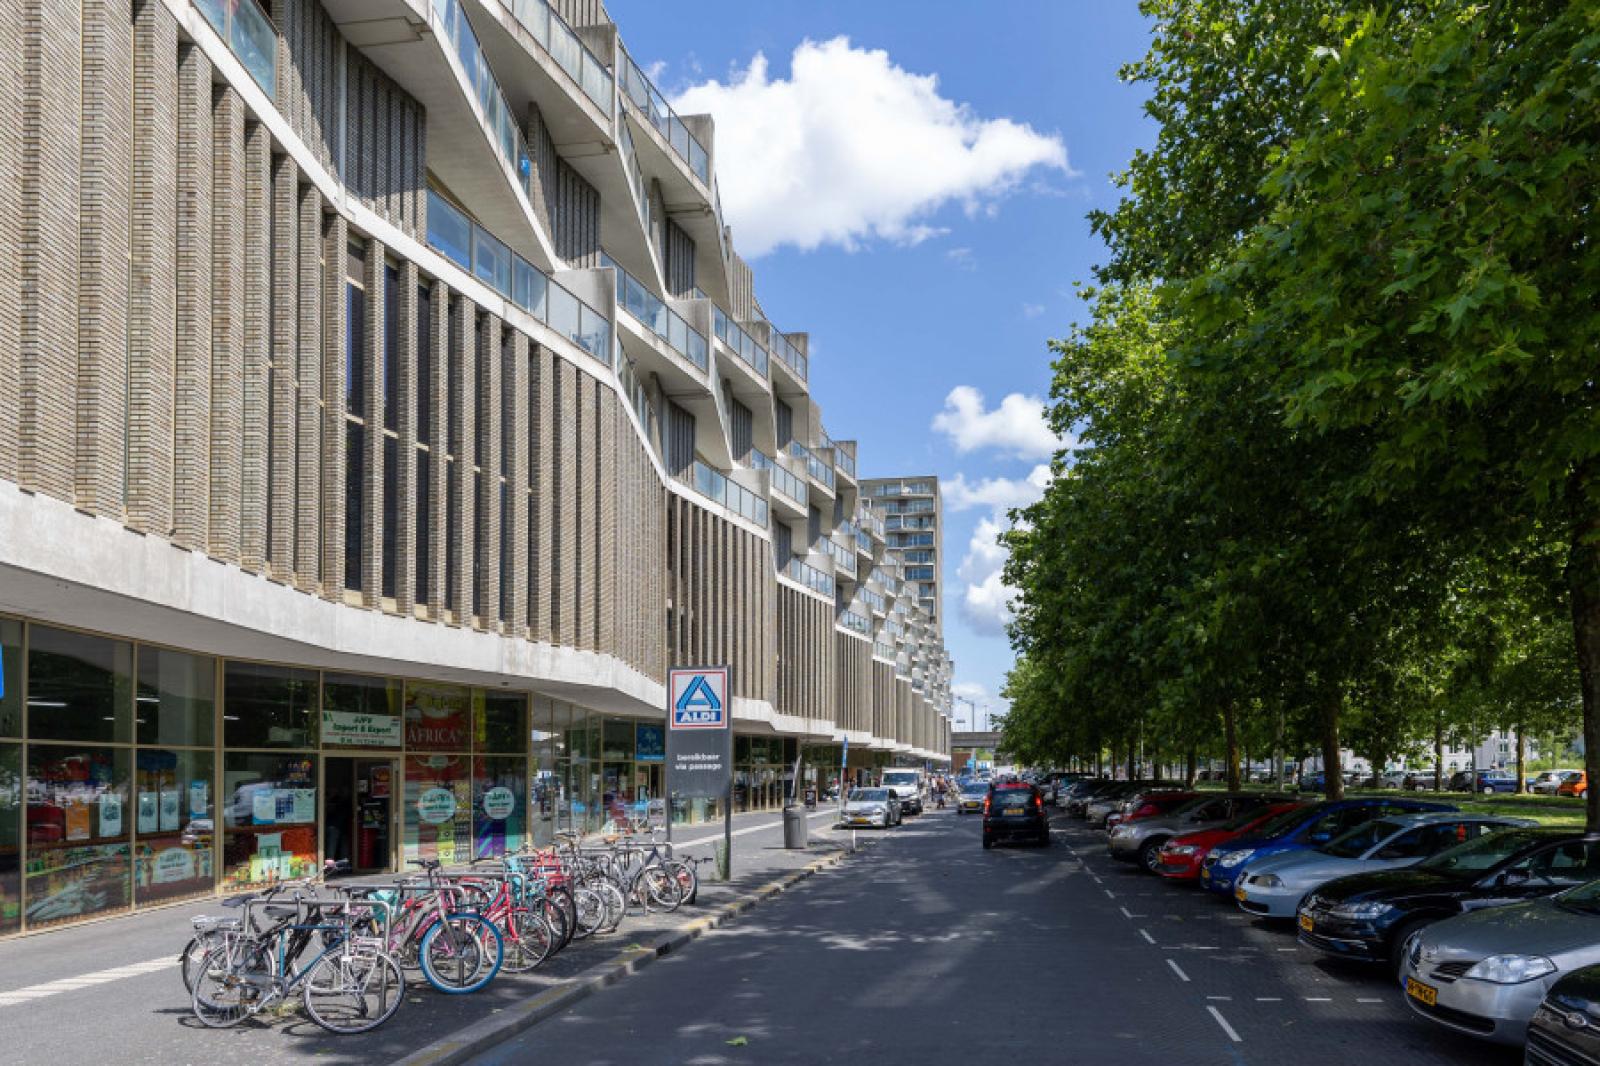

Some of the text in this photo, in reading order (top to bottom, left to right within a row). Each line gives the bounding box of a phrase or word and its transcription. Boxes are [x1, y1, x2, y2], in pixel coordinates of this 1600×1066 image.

[680, 711, 717, 722] ALDI
[333, 723, 358, 732] Import
[367, 725, 392, 735] Export
[676, 753, 720, 761] bereikbaar
[675, 762, 723, 772] via passage
